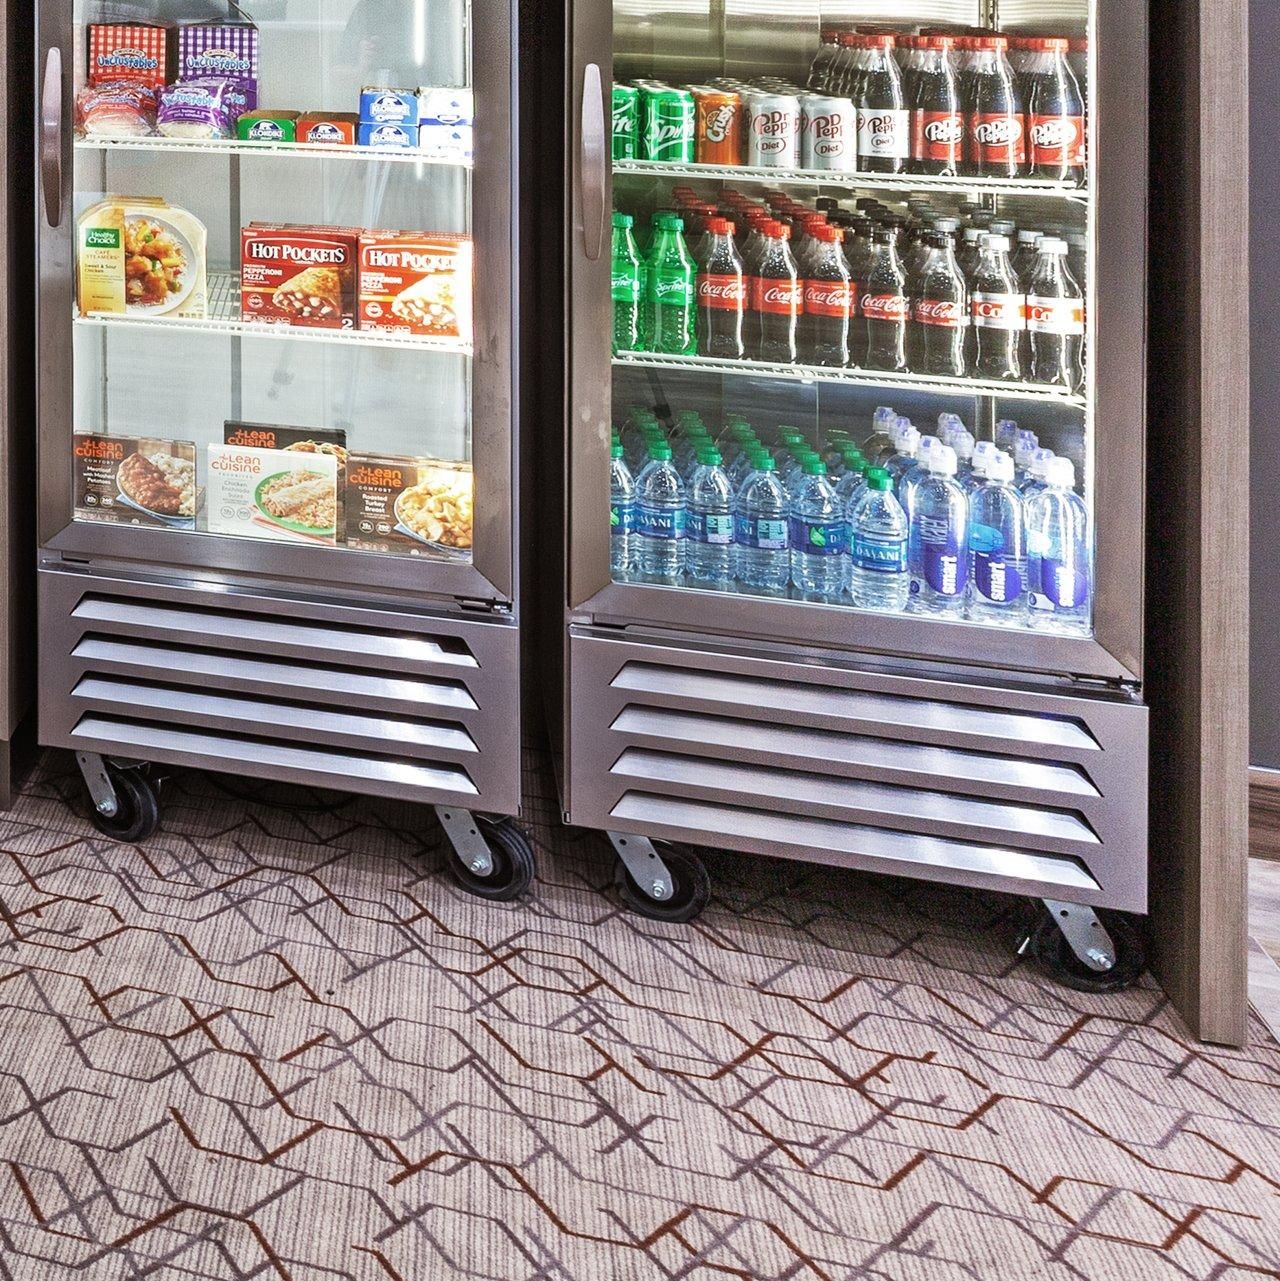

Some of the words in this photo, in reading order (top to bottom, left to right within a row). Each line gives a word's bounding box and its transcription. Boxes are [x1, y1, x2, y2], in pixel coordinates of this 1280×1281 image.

[97, 55, 159, 69] Uncrustables
[186, 55, 252, 70] Uncrustables
[760, 141, 781, 151] Diet
[875, 137, 891, 147] Diet
[820, 144, 839, 153] Diet
[91, 231, 116, 239] Healthy
[87, 236, 116, 245] Choice
[251, 243, 281, 259] HOT
[282, 244, 345, 263] POCKETS
[243, 267, 283, 276] PEPPERONI
[860, 293, 910, 313] Coca-Cola
[358, 485, 392, 493] COMFORT
[362, 493, 389, 502] Roasted
[365, 499, 386, 508] Turkey
[364, 505, 386, 514] Breast
[940, 555, 958, 595] smart
